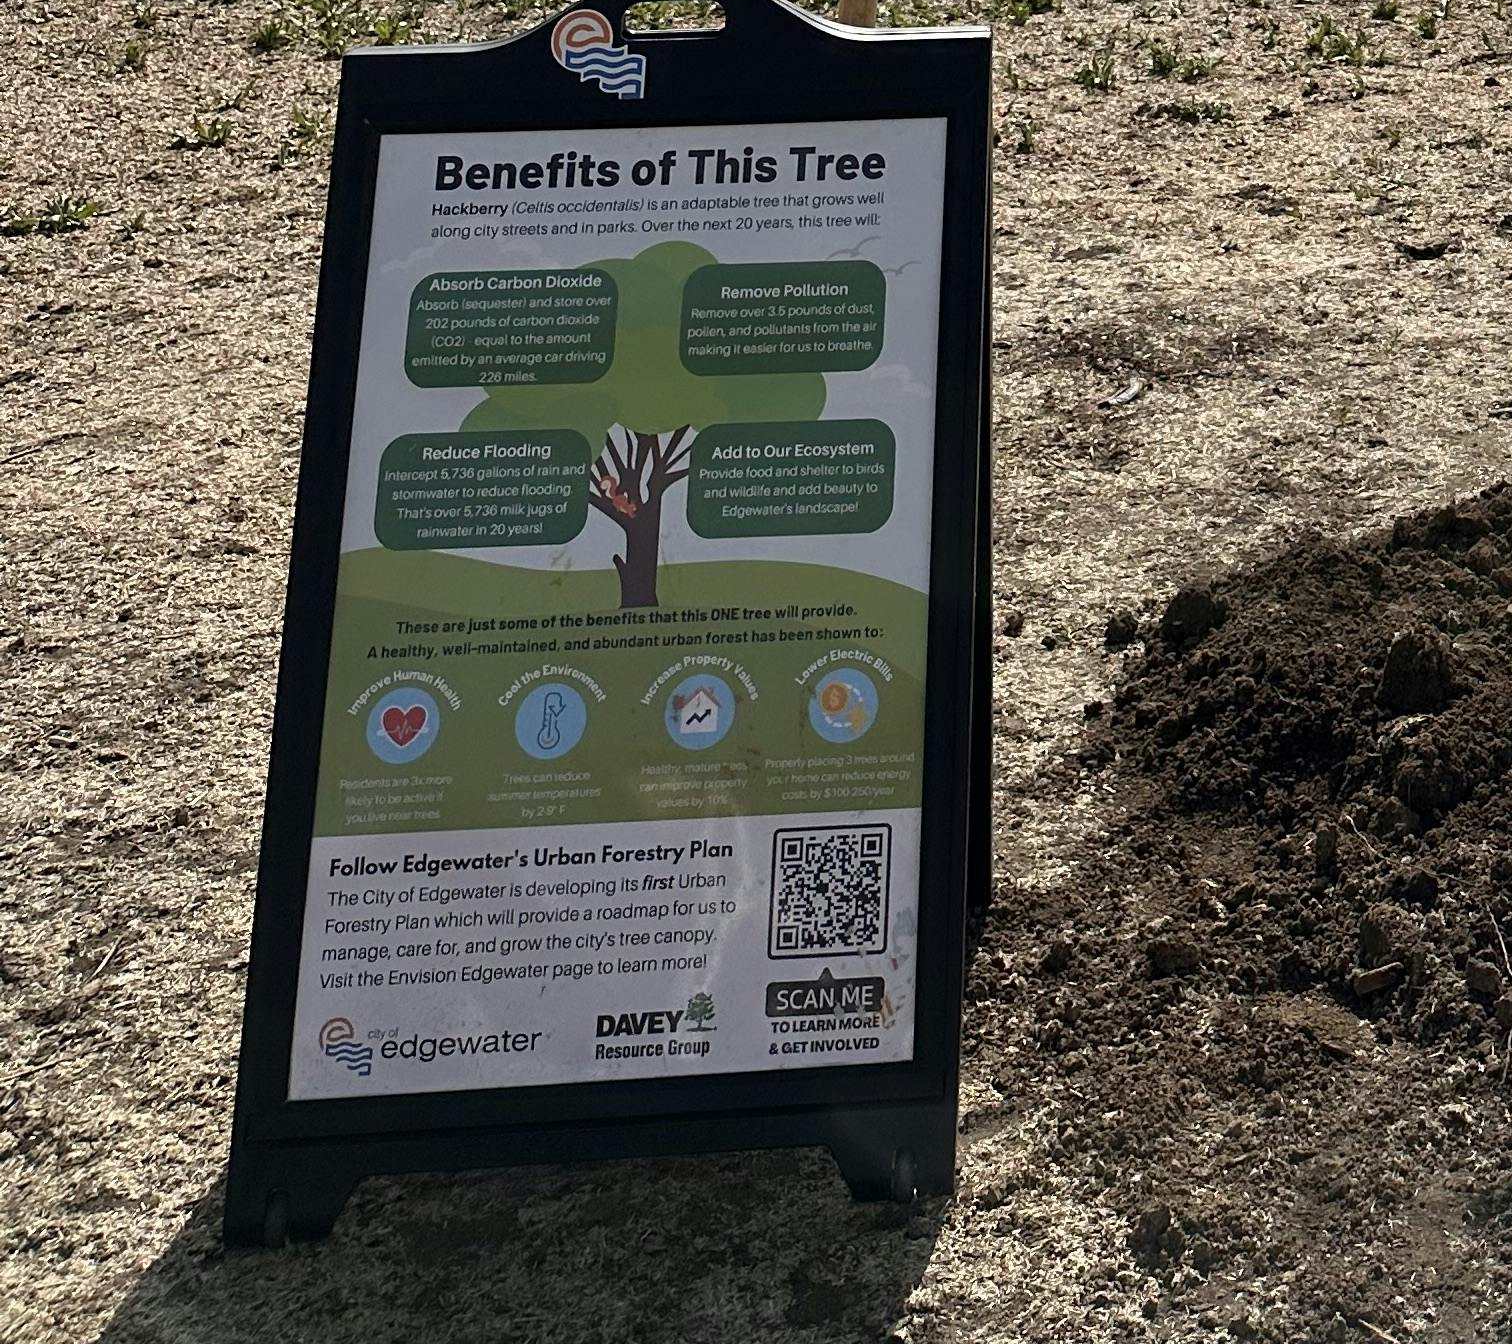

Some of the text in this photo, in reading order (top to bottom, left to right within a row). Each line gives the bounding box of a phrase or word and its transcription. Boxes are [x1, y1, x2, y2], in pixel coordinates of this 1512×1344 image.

[435, 146, 885, 190] Benefits of This Tree
[431, 191, 884, 217] Hackberry (Celtis occidentalis) is an adaptable tree that grows well
[431, 213, 880, 240] along city streets and in parks. Over the next 20 years, this tree will:
[429, 274, 601, 291] Absorb Carbon Dioxide
[721, 283, 848, 298] Remove Pollution
[415, 295, 611, 311] Absorb (sequester) and store over
[691, 308, 738, 318] Remove
[739, 308, 765, 317] over
[767, 305, 786, 316] 3.5
[787, 303, 832, 319] pounds
[833, 302, 846, 315] of
[411, 350, 606, 368] emitted by an average car driving
[688, 344, 731, 357] making
[733, 344, 740, 354] it
[742, 343, 777, 353] easier
[779, 341, 796, 353] for
[797, 343, 812, 352] us
[813, 341, 826, 352] to
[422, 443, 551, 460] Reduce Flooding
[711, 442, 874, 459] Add to Our Ecosystem
[384, 463, 586, 483] Intercept 5,736 gallons of rain and
[699, 462, 884, 479] Provide food and shelter to birds
[396, 603, 857, 634] These are just some of the benefits that this ONE tree will provide.
[367, 625, 884, 660] A healthy, well-maintained, and abundant urban forest has been shown to:
[795, 648, 894, 685] Lower Electric Bills
[347, 669, 461, 715] Improve Human Health
[498, 664, 608, 707] Cool the Environment
[640, 655, 759, 705] Increase Property Values
[329, 839, 732, 877] Follow Edgewater's Urban Forestry Plan
[327, 872, 725, 907] The City of Edgewater is developing its first Urban
[325, 899, 736, 935] Forestry Plan which will provide a roadmap for us to
[776, 984, 874, 1010] SCAN ME
[595, 1009, 684, 1037] DAVEY
[771, 1013, 879, 1033] TO LEARN MORE
[380, 1030, 542, 1062] edgewater
[595, 1039, 710, 1060] Resource Group
[768, 1037, 879, 1055] & GET INVOLVED
